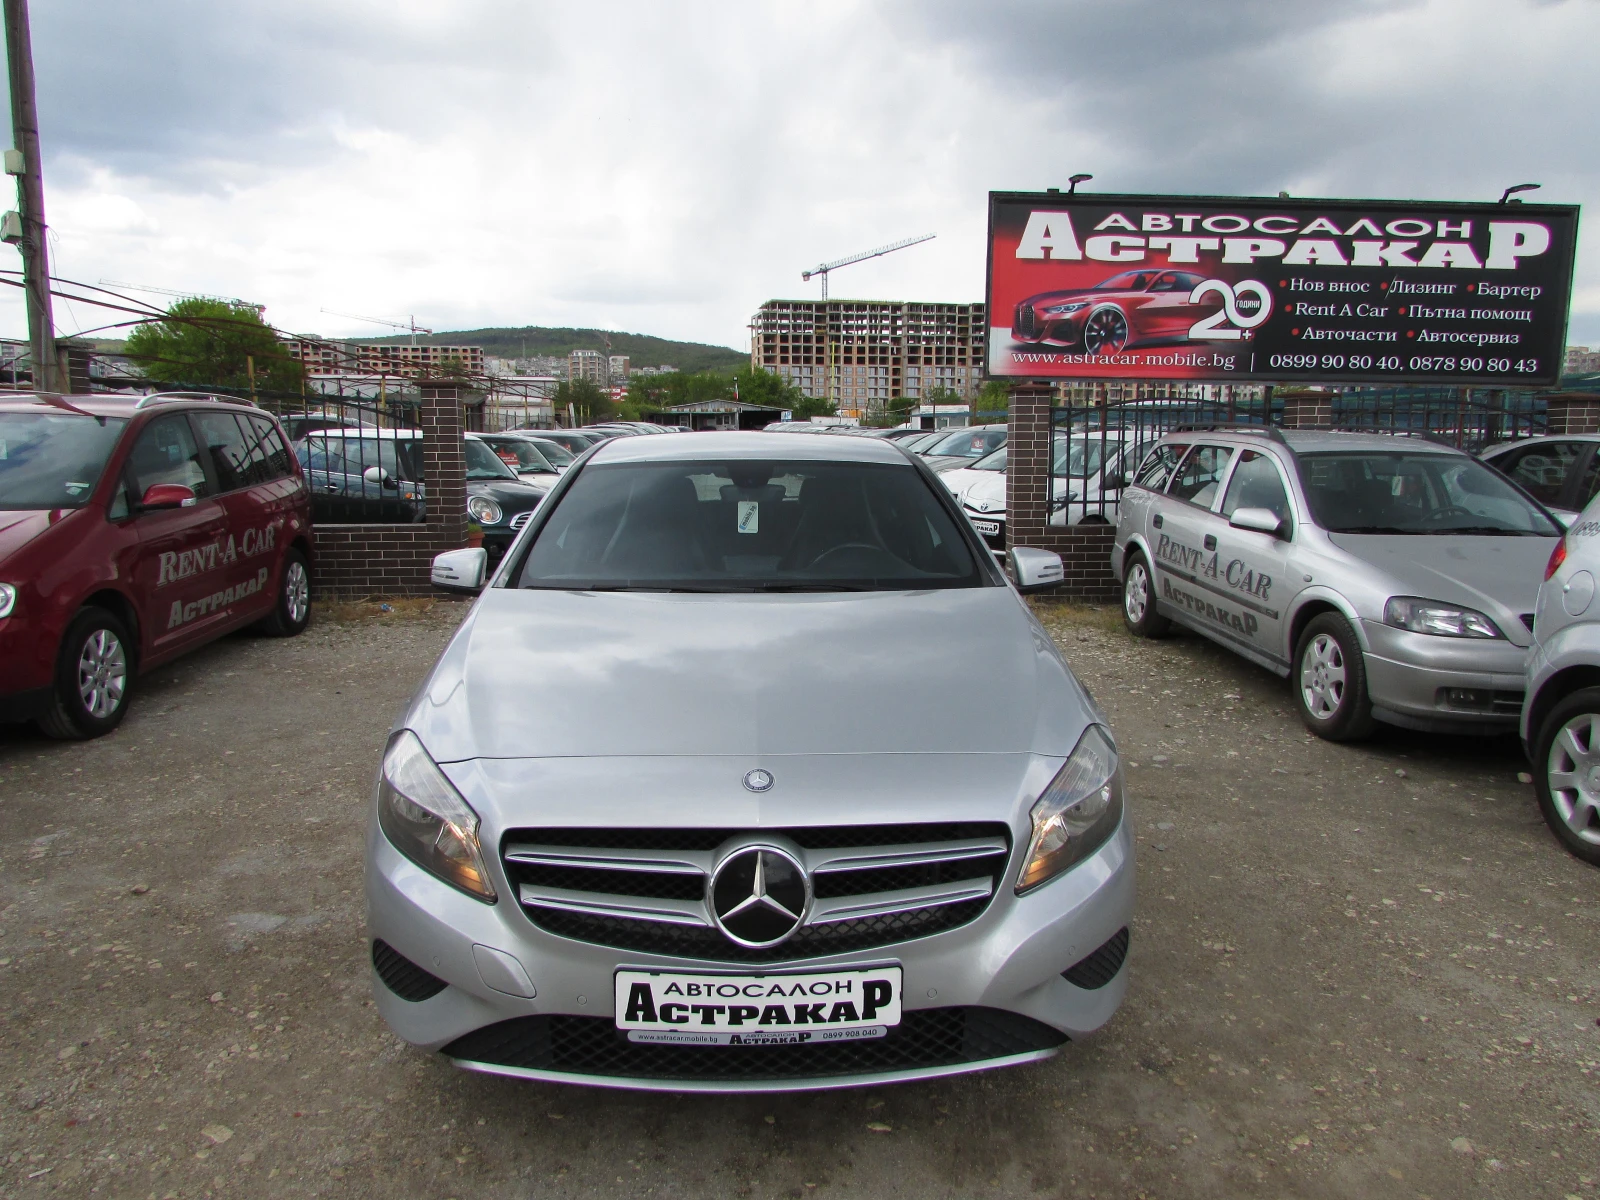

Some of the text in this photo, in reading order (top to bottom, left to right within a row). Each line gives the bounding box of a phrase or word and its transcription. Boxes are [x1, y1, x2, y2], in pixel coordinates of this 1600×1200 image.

[1093, 213, 1471, 237] АВТОСАЛОН
[1015, 211, 1550, 269] АСТРАКАР
[1289, 278, 1541, 299] Нов внос Лизинг Бартер
[1295, 303, 1388, 317] Rent A Car
[1408, 305, 1532, 322] Пътна помощ
[1301, 328, 1519, 346] Авточасти Автосервиз
[1011, 351, 1537, 373] www.astracar.mobile.bg 0899 90 80 40, 0878 90 80 43
[156, 525, 275, 586] RENT-A-CAR
[1156, 533, 1272, 602] RENT-A-CAR
[167, 567, 268, 629] АСТРАКАР
[1163, 577, 1258, 637] АСТРАКАР
[663, 980, 852, 997] АВТОСАЛОН
[625, 979, 893, 1025] АСТРАКАР
[638, 1034, 718, 1044] www.astracar.mobile.bg
[729, 1031, 811, 1045] АСТРАКАР
[845, 1030, 860, 1038] 908
